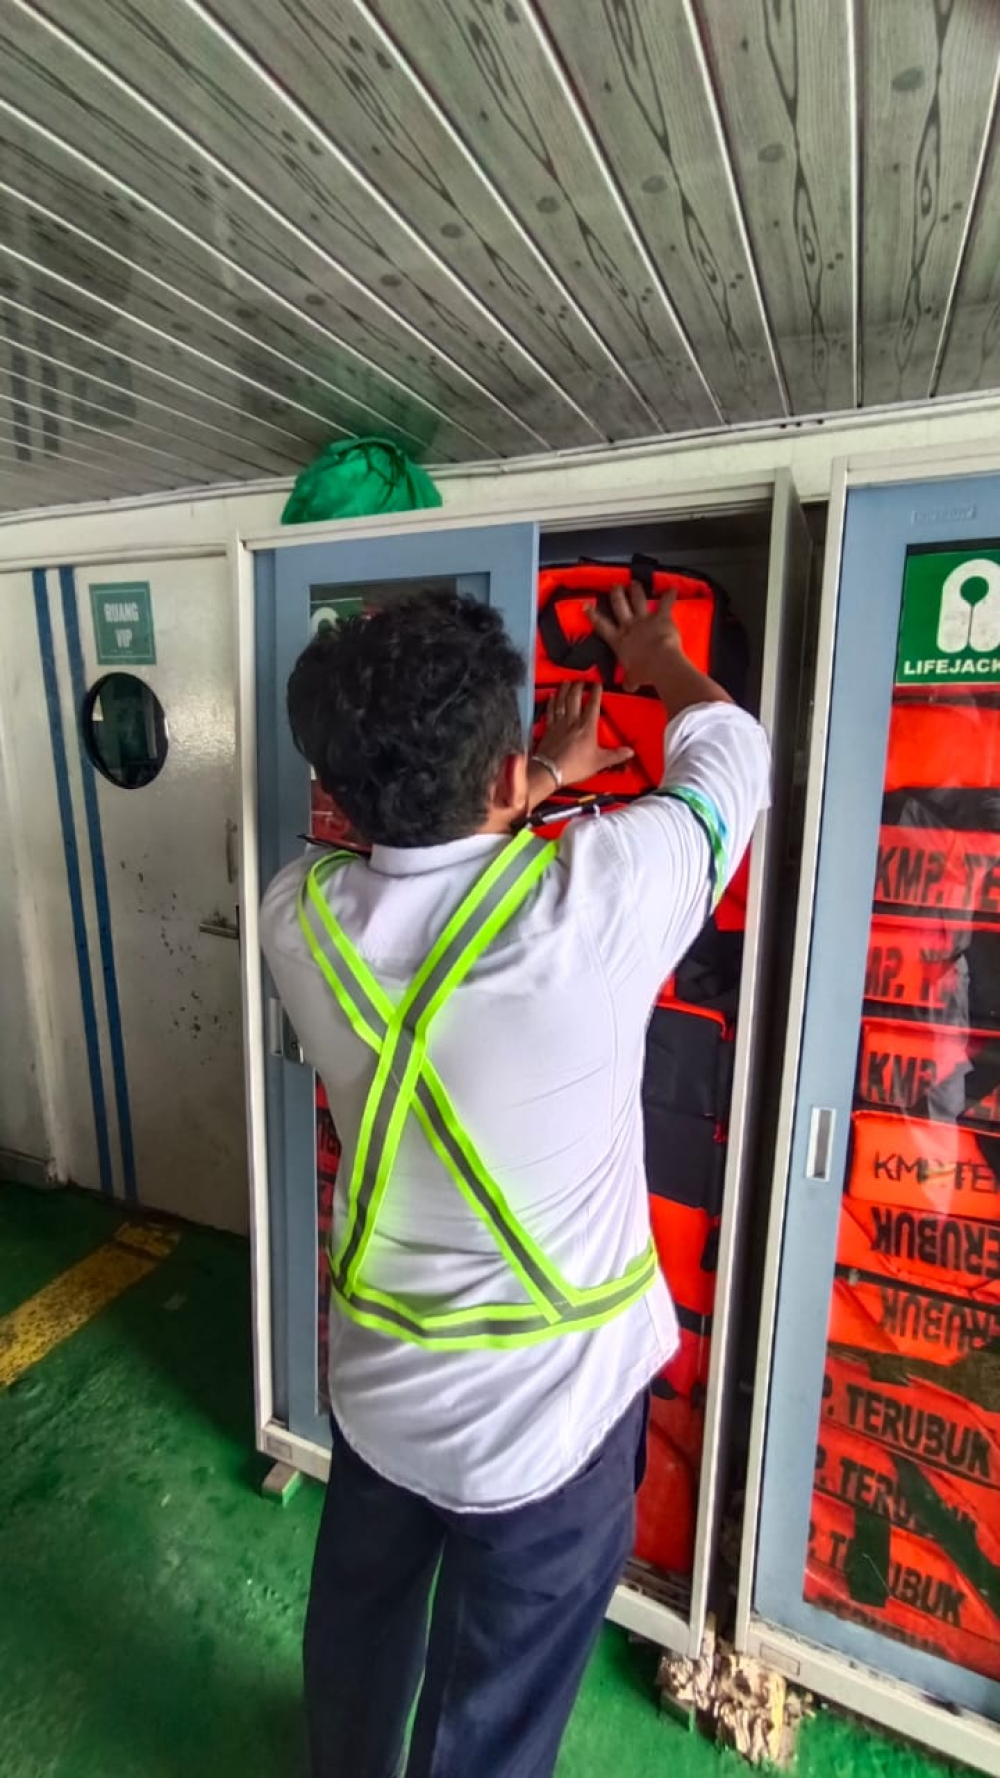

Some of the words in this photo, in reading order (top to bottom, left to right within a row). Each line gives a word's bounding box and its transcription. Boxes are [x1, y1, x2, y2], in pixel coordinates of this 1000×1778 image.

[104, 602, 139, 622] RUANG
[115, 628, 132, 648] VIP
[846, 1383, 990, 1480] TERUBUK
